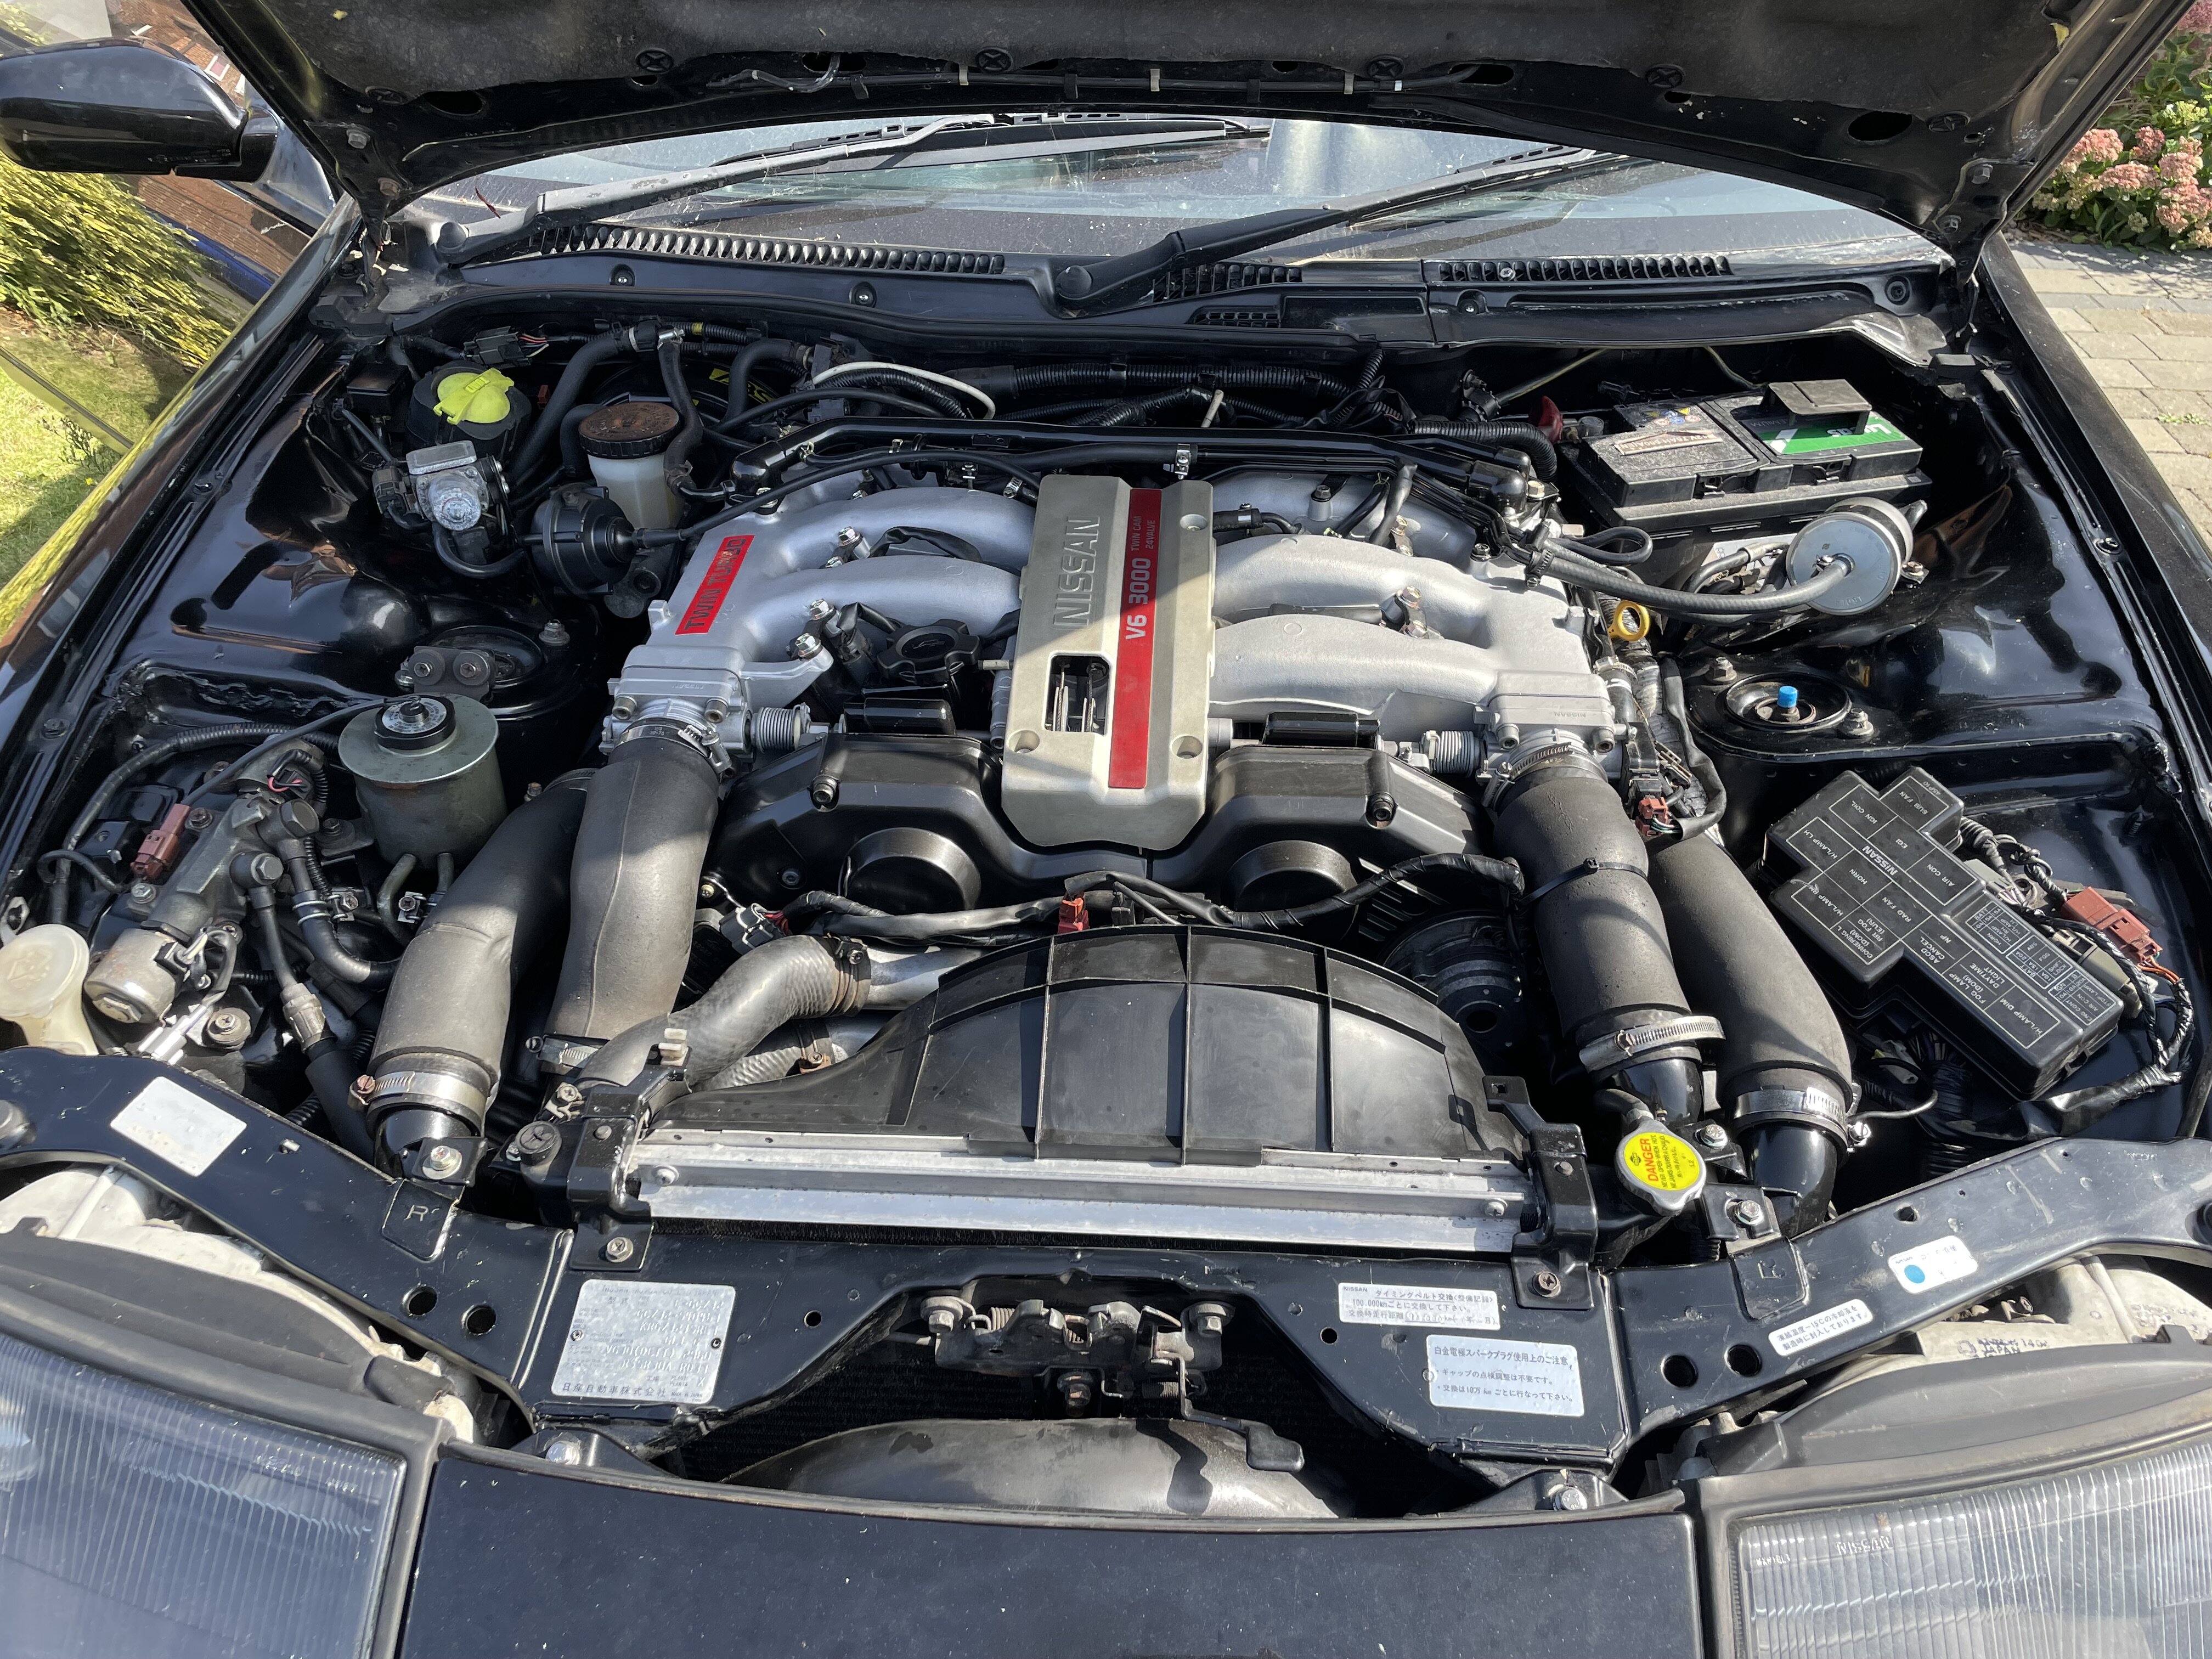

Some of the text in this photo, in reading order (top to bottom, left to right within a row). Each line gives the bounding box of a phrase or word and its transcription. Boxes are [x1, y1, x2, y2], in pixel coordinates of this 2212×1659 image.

[1827, 424, 1892, 437] Luas
[1131, 516, 1142, 551] TWIN CAM
[1146, 520, 1155, 549] 24VALVE
[1053, 516, 1100, 626] NISSAN
[684, 589, 721, 630] TWIN
[1125, 558, 1151, 640] V6 3000
[1851, 800, 1878, 824] IGN COIL
[1899, 791, 1928, 815] SUB FAN
[1803, 830, 1838, 859] H/LAMP LH
[1895, 838, 1908, 849] EGI
[1861, 845, 1898, 876] NISSAN
[1849, 868, 1867, 885] HORN
[1926, 864, 1955, 887] AIR CON
[1818, 895, 1844, 917] H/LAMP
[1882, 896, 1912, 923] RAD FAN
[1974, 907, 1989, 921] BATT
[1857, 918, 1884, 942] RR FOG
[1866, 917, 1886, 935] (EUR)
[1991, 926, 2012, 943] H/LAMP
[1841, 930, 1874, 959] CORNERING
[1849, 929, 1870, 947] (DOM)
[1920, 936, 1945, 960] CANCEL
[1987, 933, 2002, 946] HORN
[2026, 941, 2038, 951] ABS
[1921, 947, 1940, 964] ASCD
[2015, 950, 2028, 961] 20A
[2038, 952, 2051, 962] FOG
[1969, 962, 2000, 989] DAYTIME
[1984, 967, 2006, 985] LIGHT
[2019, 964, 2036, 978] BATT
[2052, 964, 2067, 976] LOCK
[1949, 973, 1987, 1005] FOG LAMP
[1962, 974, 1984, 993] (DOM)
[2066, 1000, 2093, 1022] ENG CONT
[2076, 994, 2099, 1011] AIR CON
[2000, 997, 2044, 1037] H/LAMP DIM
[1639, 1137, 1659, 1182] DANGER
